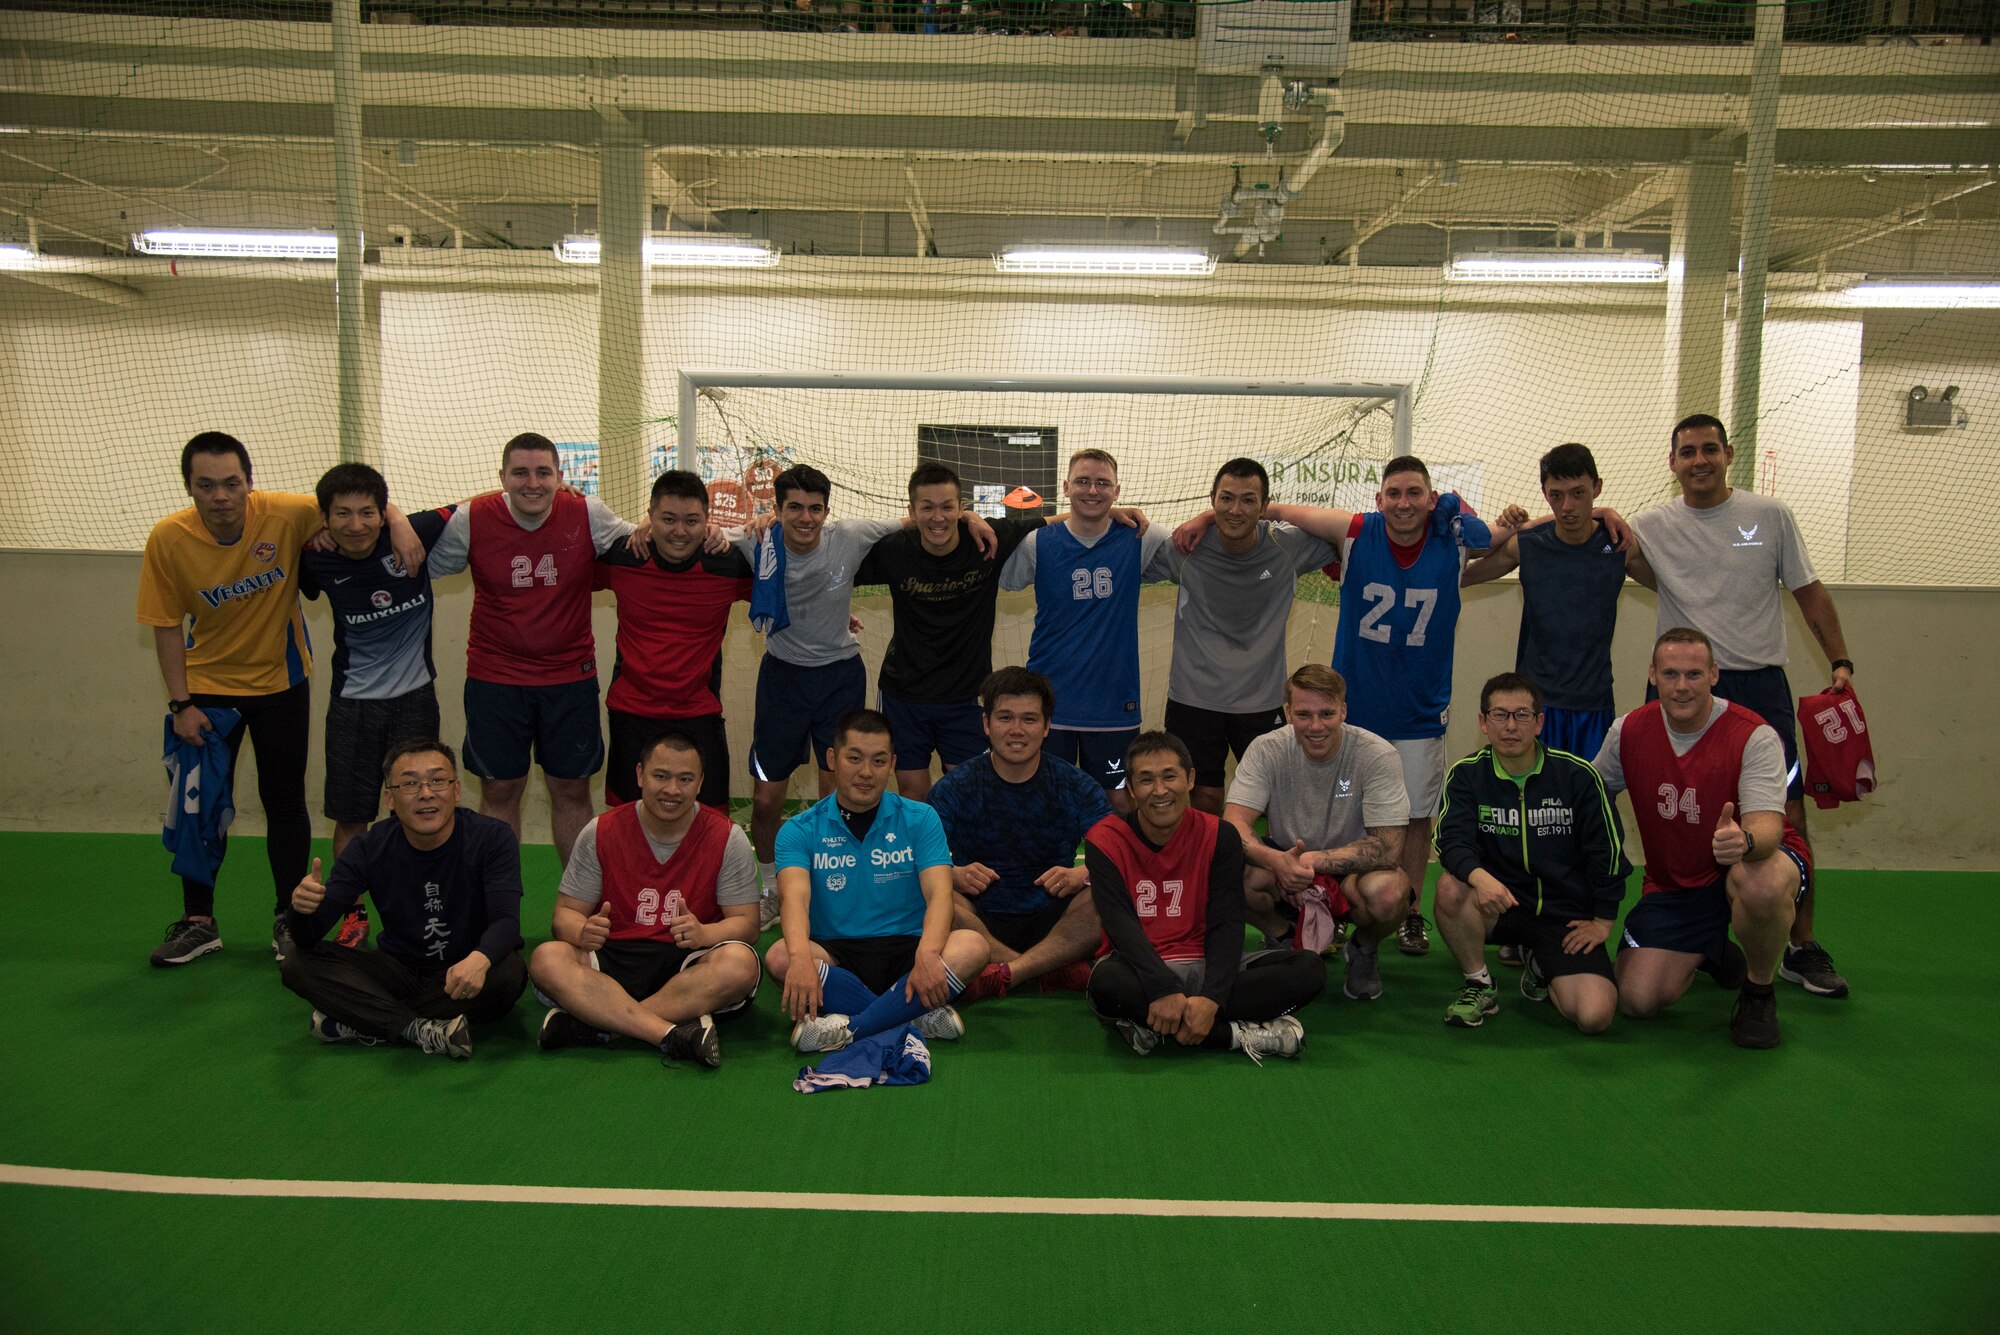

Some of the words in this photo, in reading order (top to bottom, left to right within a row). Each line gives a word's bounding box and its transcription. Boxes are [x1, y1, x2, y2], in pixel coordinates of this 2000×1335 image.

[561, 453, 599, 477] AME
[1297, 461, 1384, 484] INSURA
[713, 492, 737, 508] $25
[1296, 492, 1331, 504] FRIDAY
[200, 565, 287, 608] VEGALTA
[511, 553, 557, 587] 24
[1072, 566, 1113, 600] 26
[1359, 581, 1438, 647] 27
[1541, 798, 1563, 807] FILA
[1657, 783, 1699, 824] 34
[1478, 822, 1519, 836] FORWARD
[813, 853, 857, 870] Move
[870, 846, 914, 869] Sport
[635, 888, 682, 926] 29
[1135, 880, 1184, 917] 27
[424, 881, 452, 961] 自称天才
